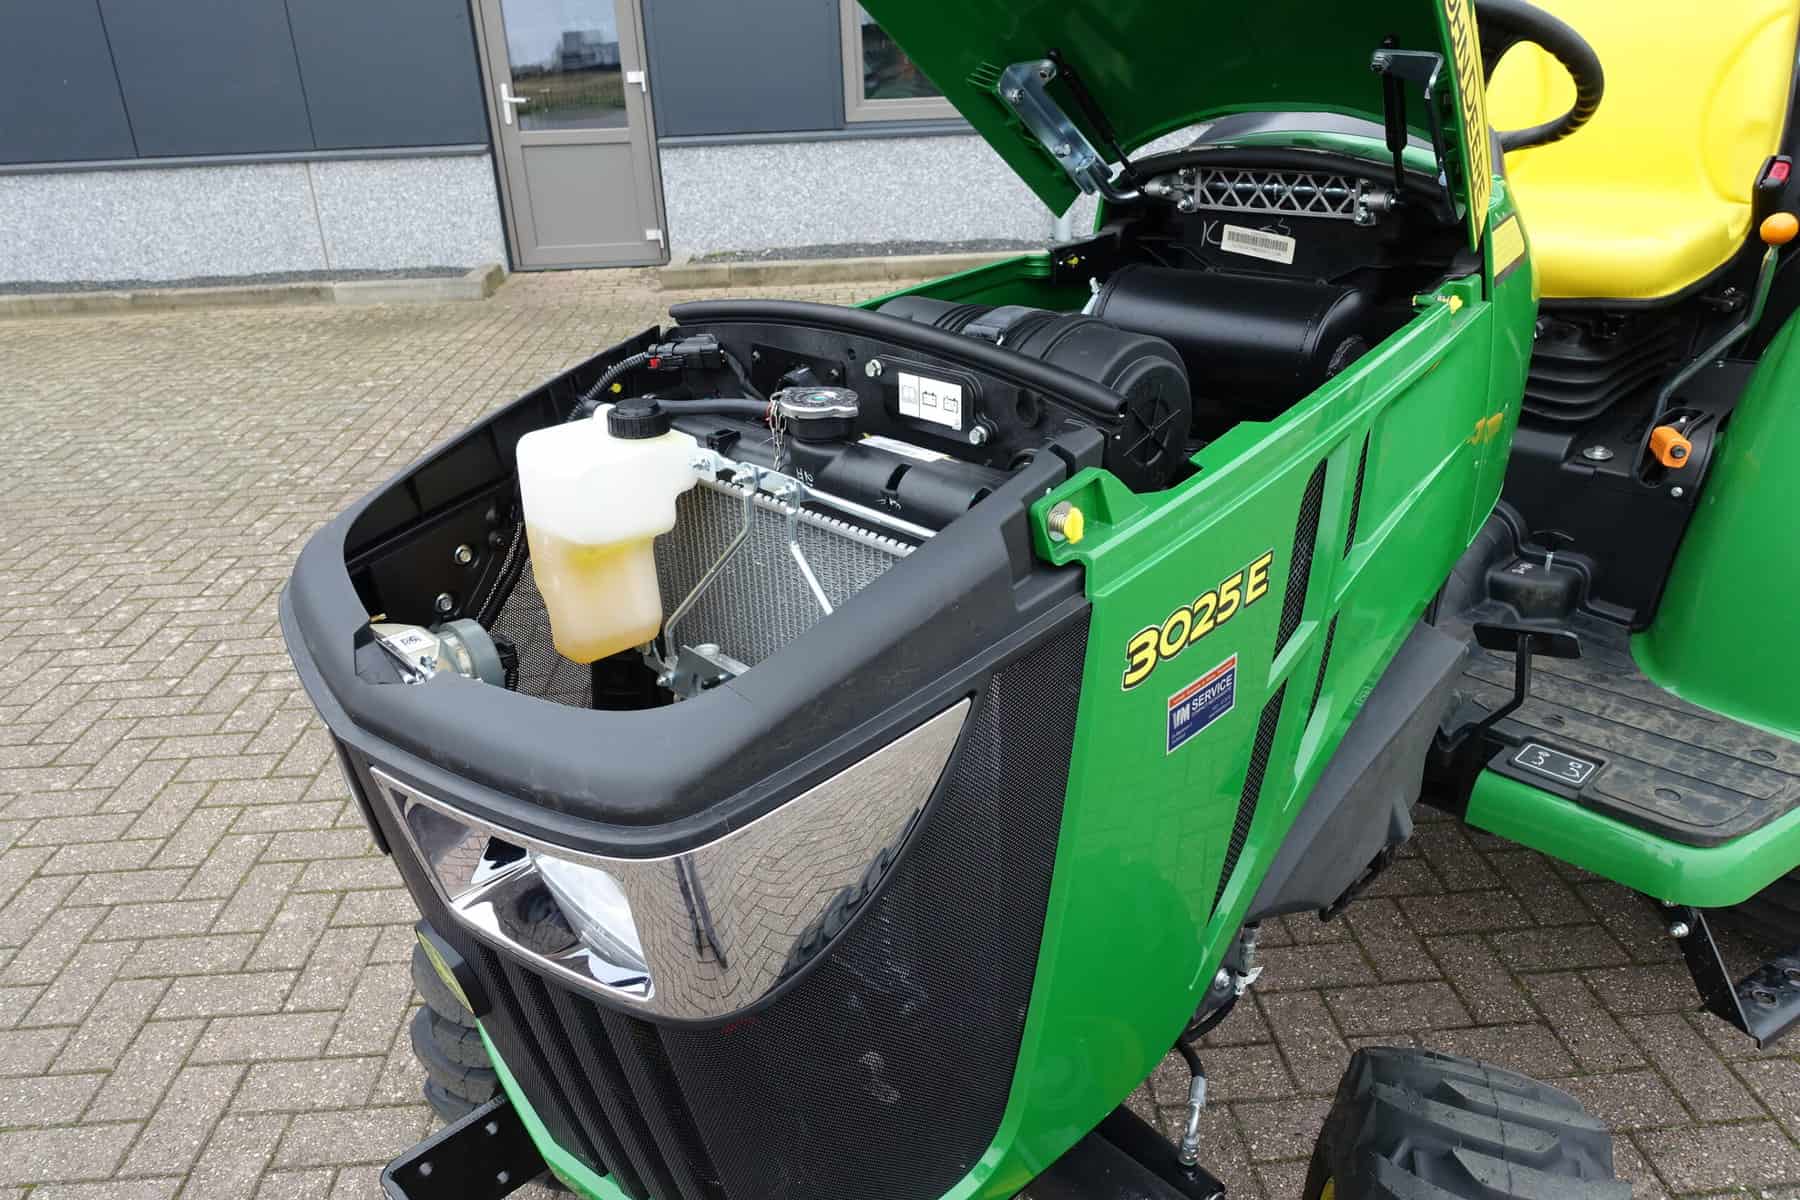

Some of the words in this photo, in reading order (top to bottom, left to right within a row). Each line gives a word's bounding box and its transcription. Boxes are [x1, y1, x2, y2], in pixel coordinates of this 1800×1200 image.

[1464, 66, 1486, 209] DEERE
[1122, 549, 1274, 689] 3025E
[1191, 673, 1233, 711] SERVICE
